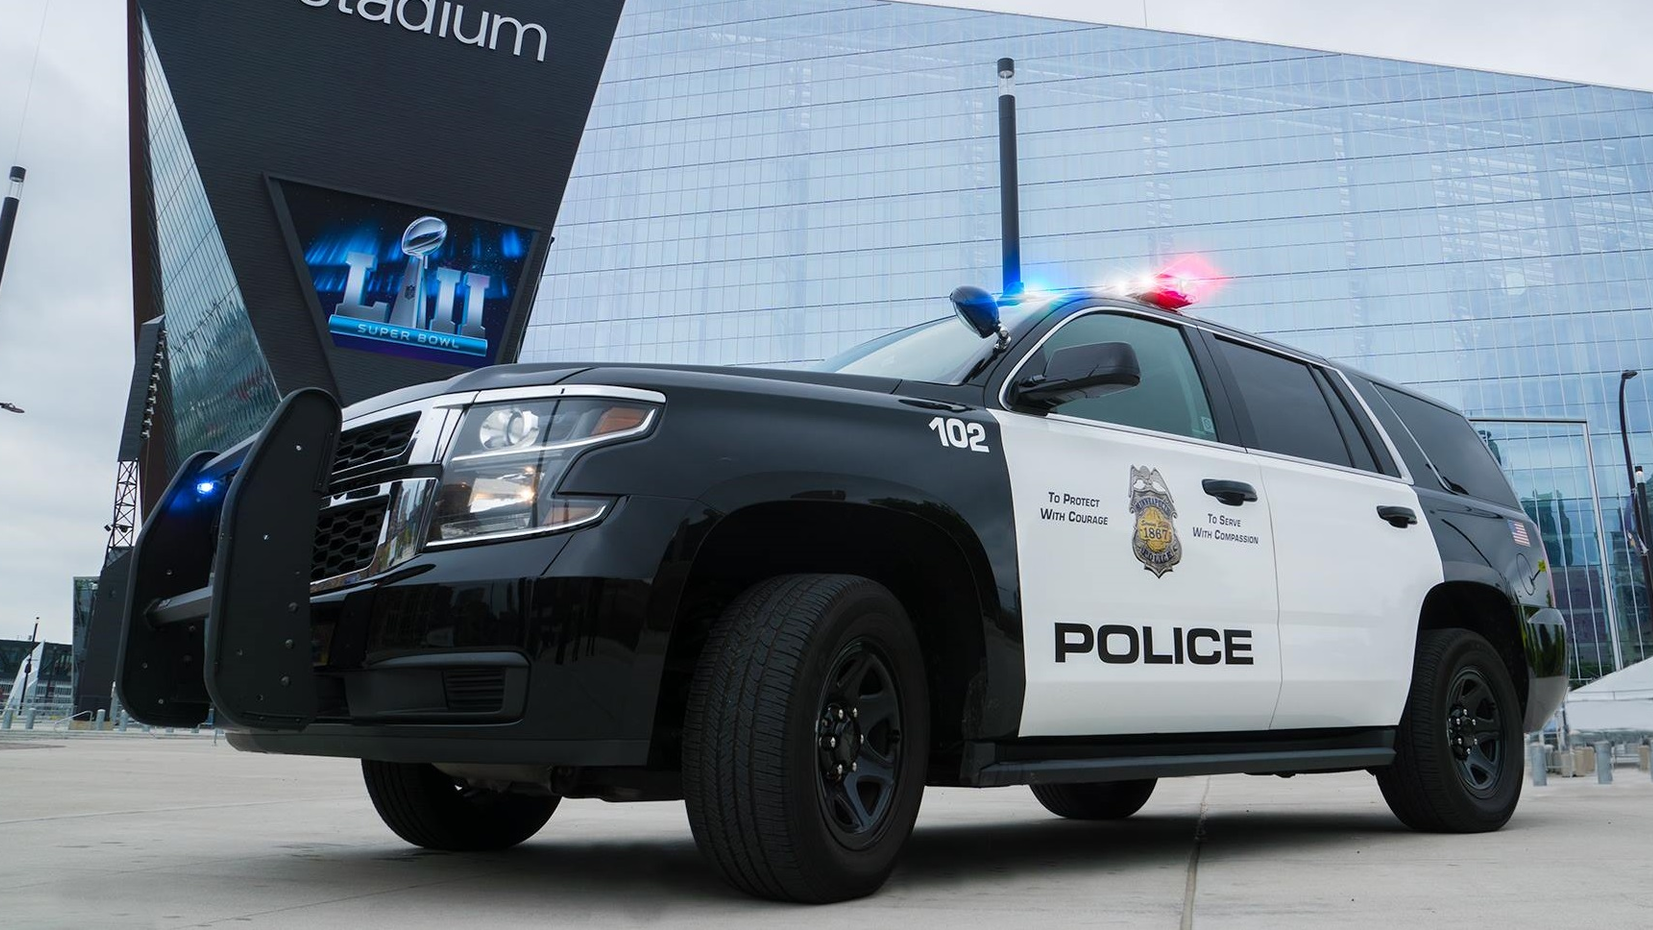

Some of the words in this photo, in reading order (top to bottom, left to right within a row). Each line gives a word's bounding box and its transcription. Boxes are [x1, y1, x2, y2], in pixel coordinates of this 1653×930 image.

[301, 0, 548, 62] adium
[357, 323, 410, 341] SUPER
[417, 333, 460, 349] BOWL
[928, 416, 990, 453] 102
[1143, 527, 1169, 540] 1867
[1140, 547, 1173, 564] POLICE
[1054, 622, 1254, 665] POLICE
